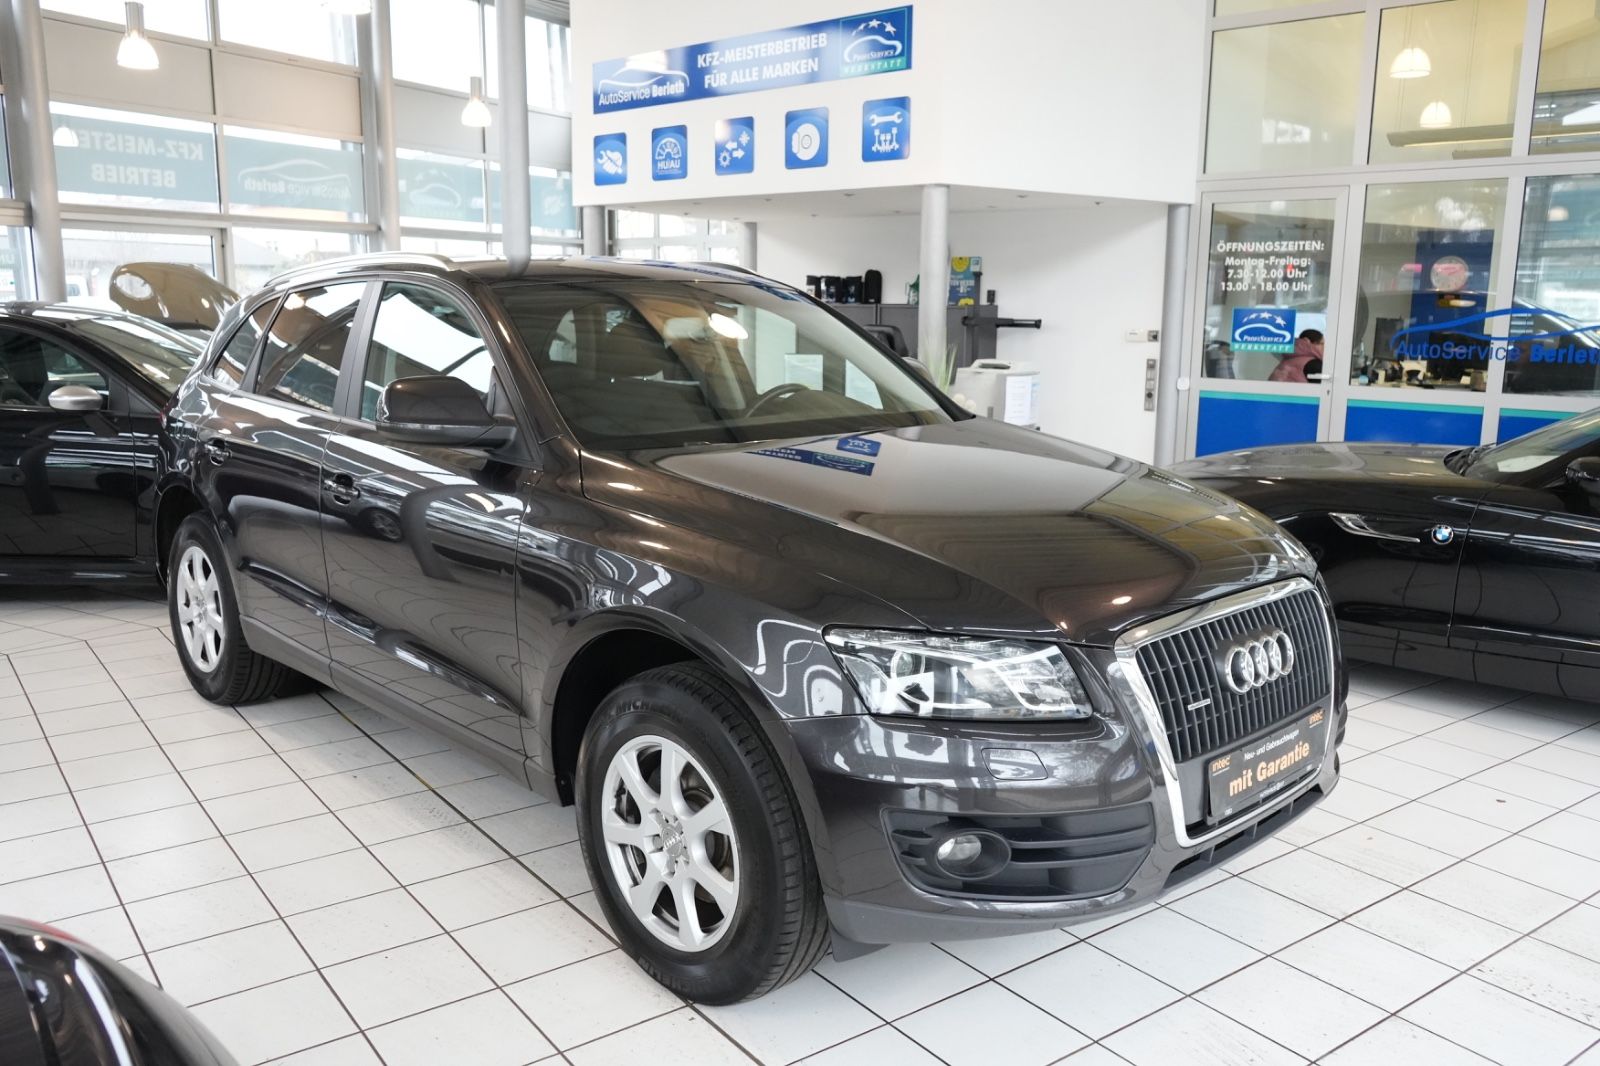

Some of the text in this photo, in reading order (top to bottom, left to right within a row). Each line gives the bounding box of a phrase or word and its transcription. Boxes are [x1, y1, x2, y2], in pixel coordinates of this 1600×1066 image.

[697, 32, 828, 68] KFZ-MEISTERBETRIEB
[704, 57, 819, 89] FÜR ALLE MARKEN
[599, 79, 685, 106] AutoService Berleth
[1217, 240, 1325, 253] ÖFFNUNGSZEITEN:
[1225, 256, 1311, 268] Montag-Freitag:
[1227, 267, 1307, 279] 7.30-12.00 Uhr
[1221, 281, 1249, 291] 13.00
[1260, 281, 1289, 291] 18.00
[1292, 281, 1313, 291] Uhr
[1394, 341, 1600, 365] AutoService Berlet
[1212, 755, 1230, 772] intec
[1229, 768, 1253, 797] mit
[1256, 741, 1310, 782] Garantie
